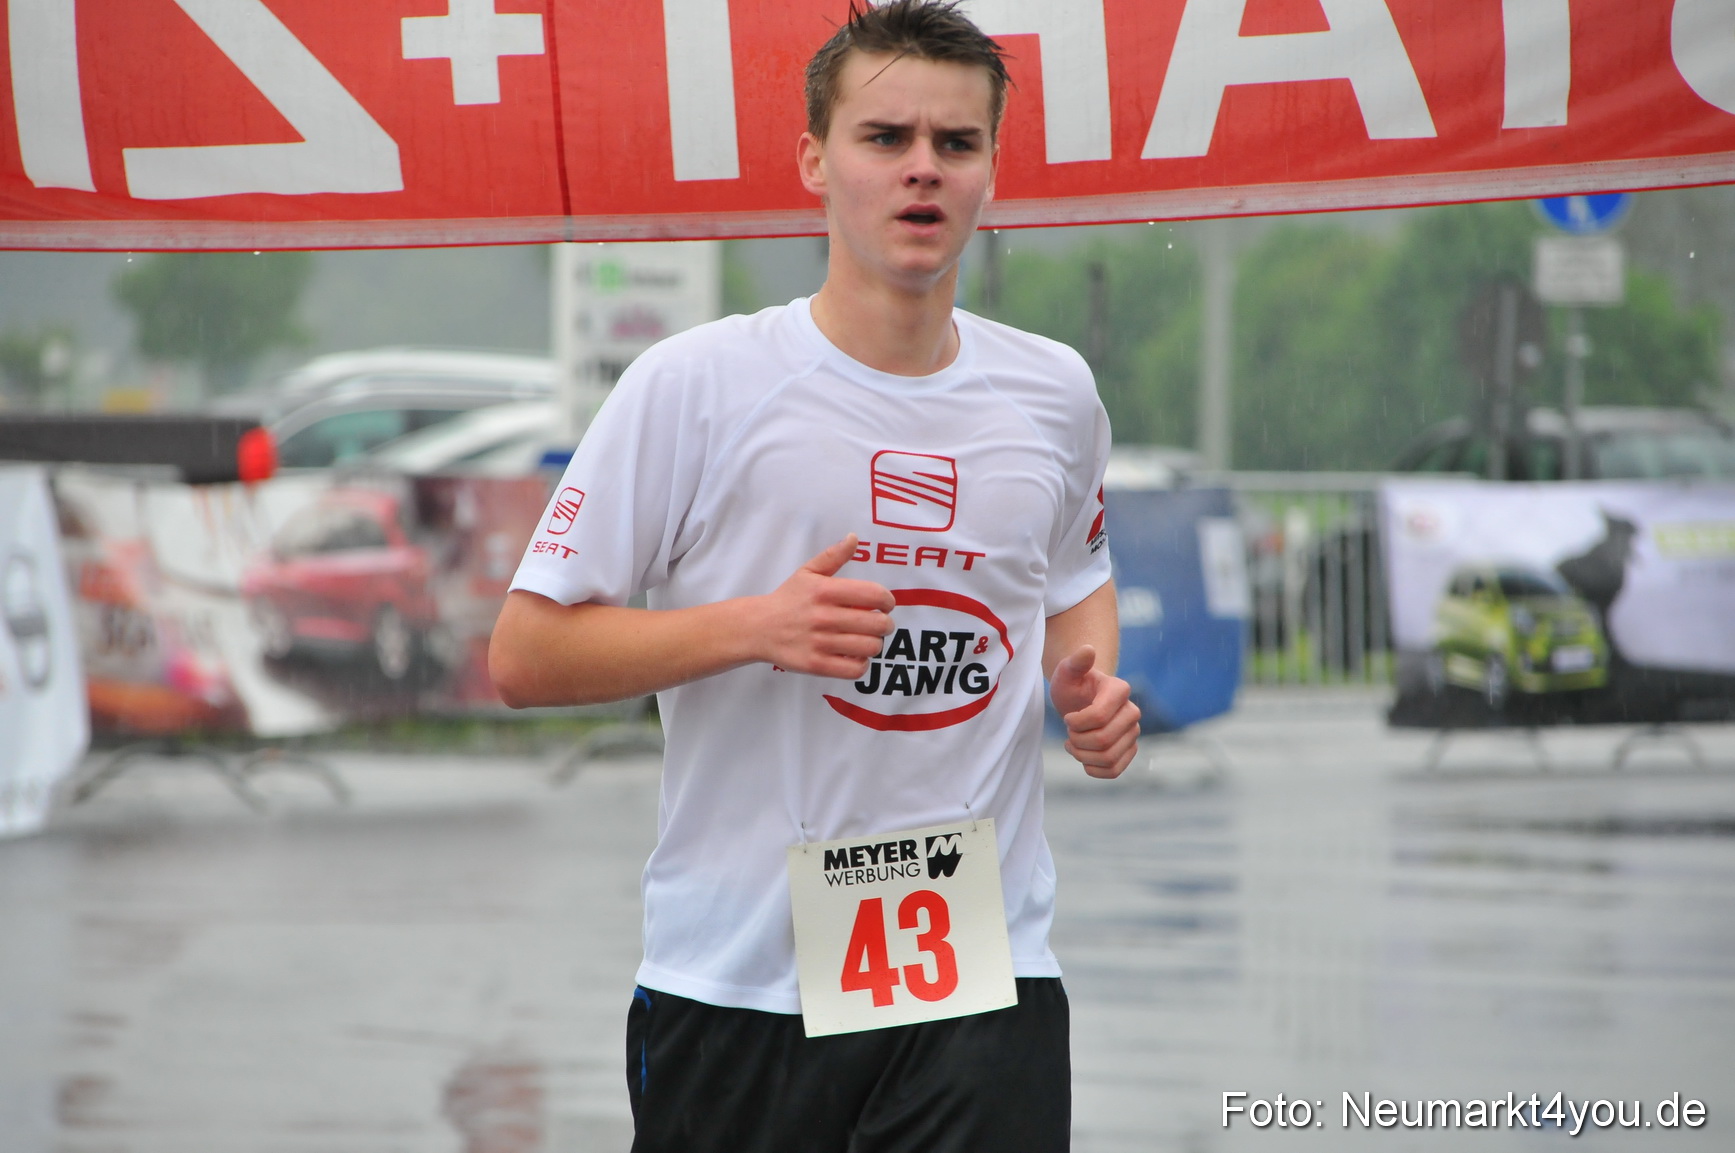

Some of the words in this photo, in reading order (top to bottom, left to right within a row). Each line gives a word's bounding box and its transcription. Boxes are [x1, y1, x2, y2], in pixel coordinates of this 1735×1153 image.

[532, 541, 578, 559] SEAT
[851, 541, 986, 571] SEAT
[854, 662, 990, 697] JÄNIG
[823, 838, 920, 872] MEYER
[824, 861, 921, 887] WERBUNG
[840, 889, 959, 1008] 43
